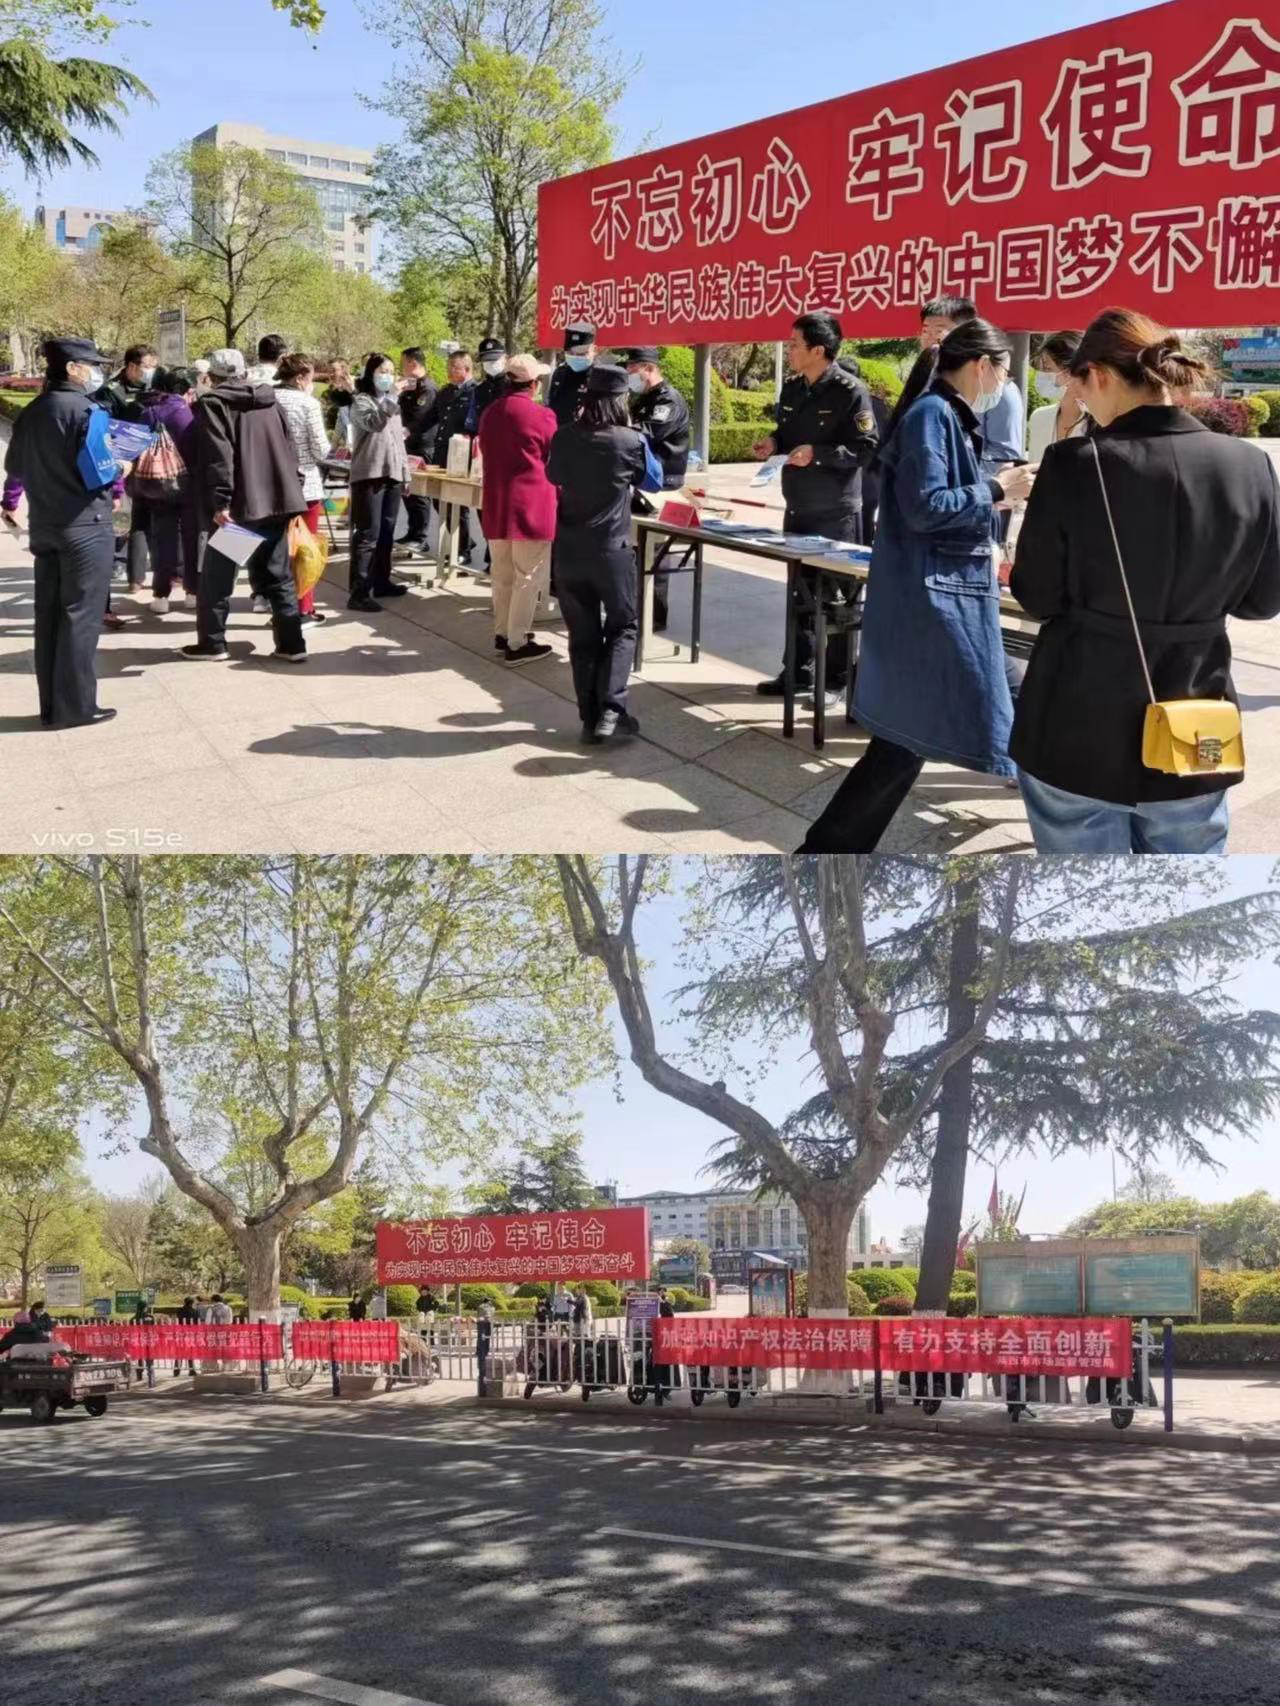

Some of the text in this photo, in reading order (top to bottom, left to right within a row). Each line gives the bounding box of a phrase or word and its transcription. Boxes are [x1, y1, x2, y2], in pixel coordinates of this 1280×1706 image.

[591, 18, 1280, 260] 不忘初心 牢记使命
[550, 195, 1280, 329] 为实现中华民族伟大复兴的中国梦不懈
[406, 1217, 606, 1255] 不忘初心 牢记使命
[385, 1252, 636, 1279] 为实现中华民族伟大复兴的中国梦不懈奋斗
[660, 1327, 1115, 1357] 加强知识产权法治保障 有力支持全面创新
